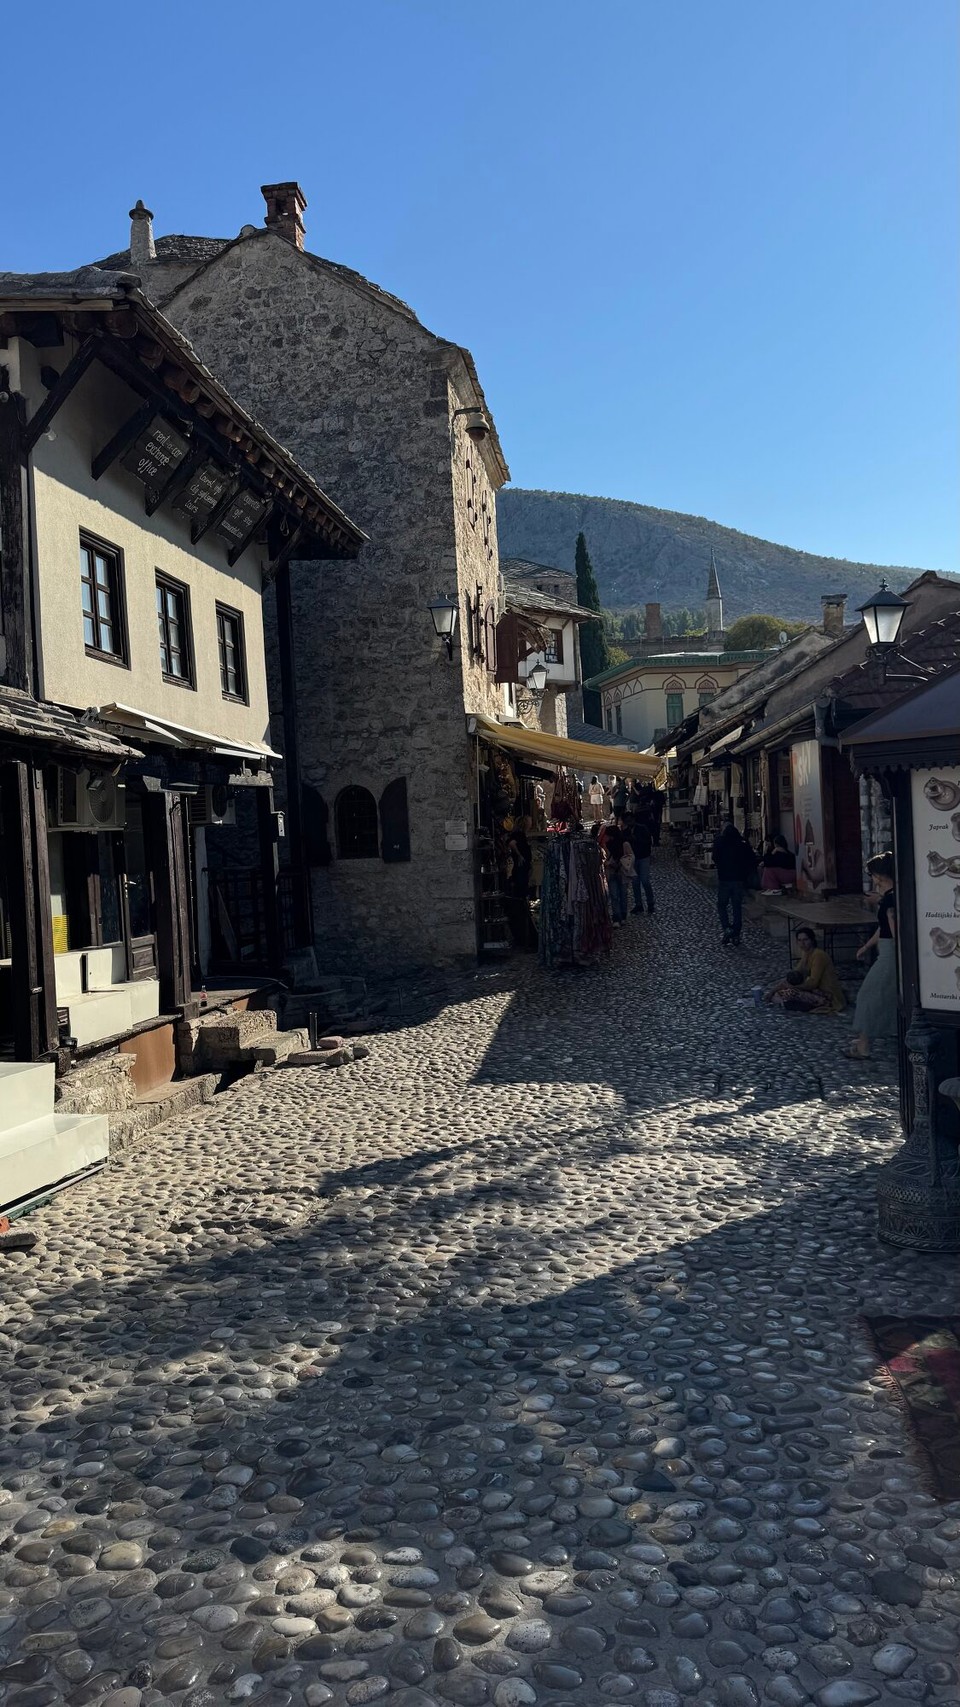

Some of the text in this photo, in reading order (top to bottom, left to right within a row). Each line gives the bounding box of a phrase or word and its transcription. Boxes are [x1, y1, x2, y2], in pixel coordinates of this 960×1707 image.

[145, 441, 170, 467] exchange
[152, 429, 183, 458] rent-a-car
[137, 458, 158, 477] office
[928, 823, 949, 832] Japrak
